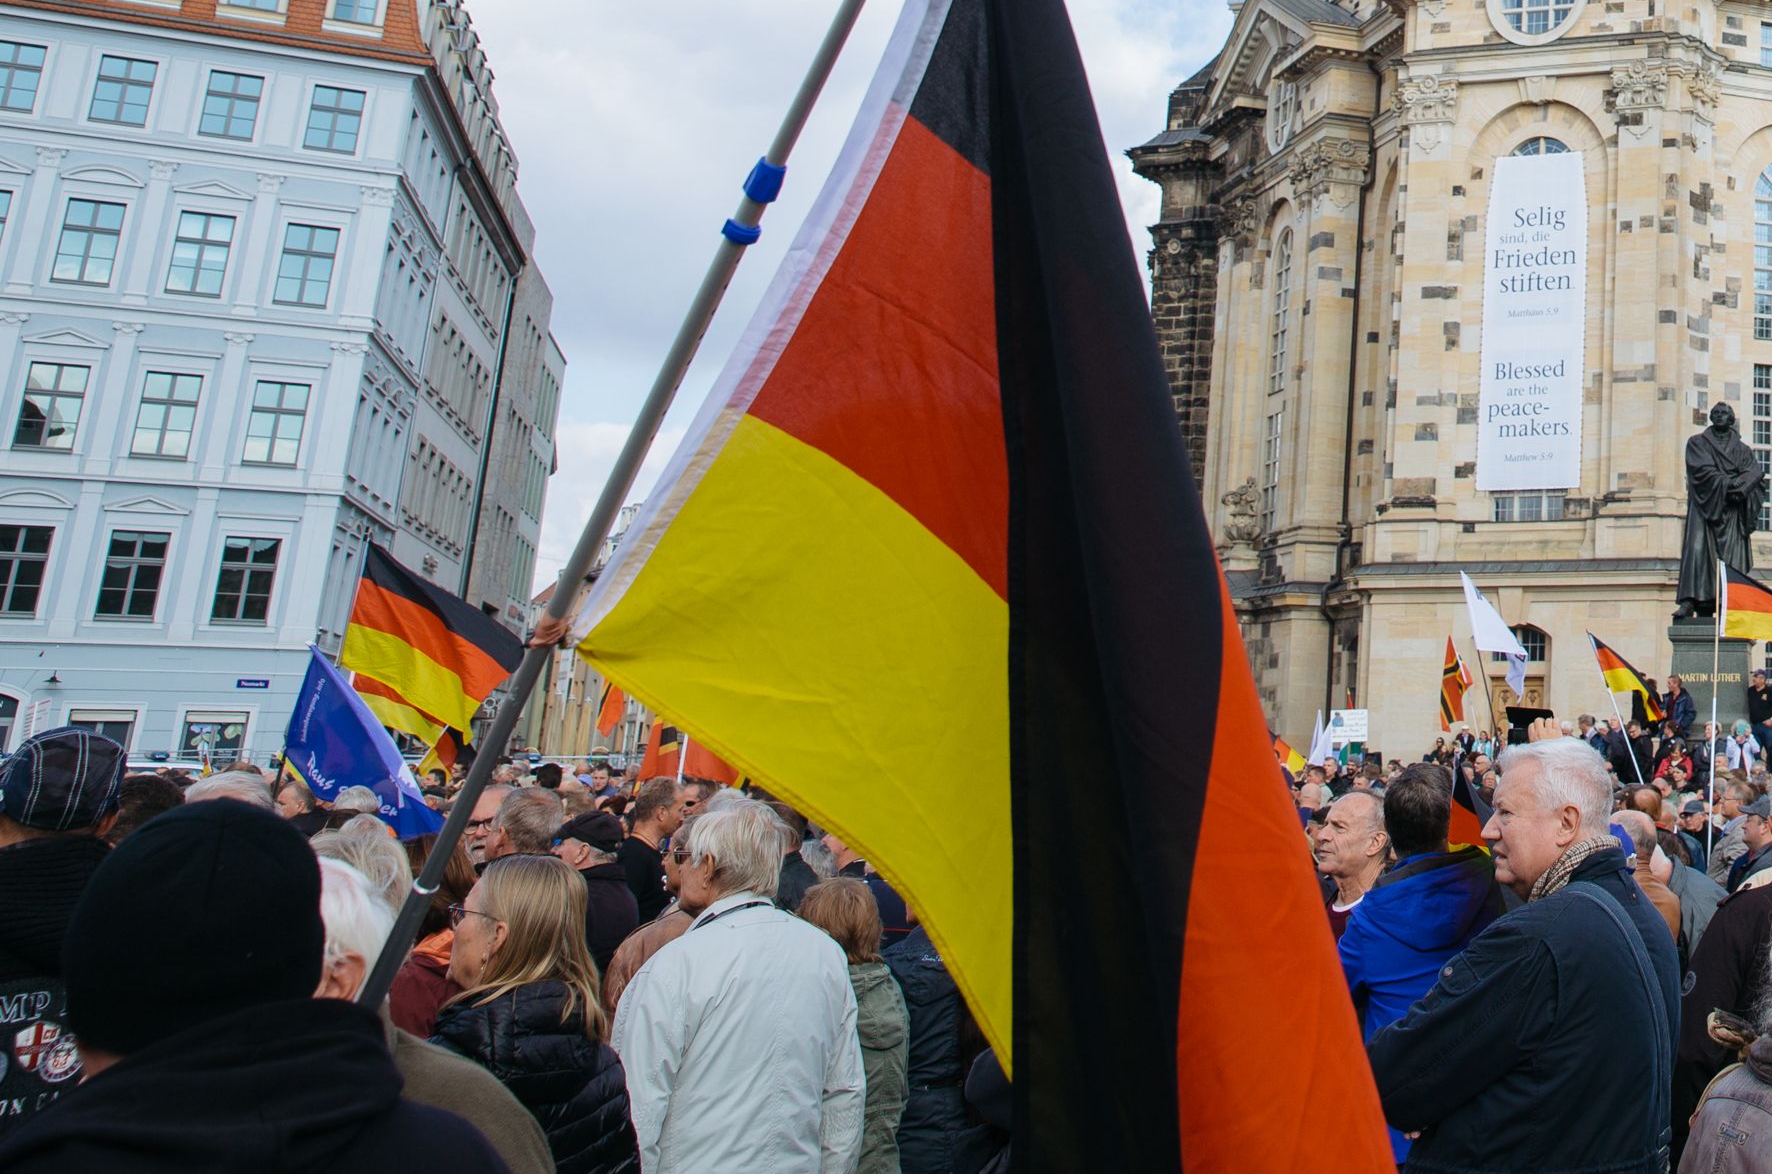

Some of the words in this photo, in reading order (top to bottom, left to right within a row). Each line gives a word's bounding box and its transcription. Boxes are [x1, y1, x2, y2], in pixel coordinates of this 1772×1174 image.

[1513, 206, 1566, 231] Selig
[1499, 232, 1527, 245] sind,
[1532, 230, 1550, 243] die
[1493, 246, 1576, 269] Frieden
[1499, 271, 1575, 294] stiften.
[1495, 359, 1564, 380] Blessed
[1506, 386, 1524, 396] are
[1528, 384, 1548, 395] the
[1488, 401, 1550, 423] peace-
[1498, 418, 1573, 438] makers.
[1504, 453, 1538, 462] Matthew
[1679, 673, 1708, 683] MARTIN
[1711, 673, 1741, 683] LUTHER
[307, 751, 336, 790] Raus
